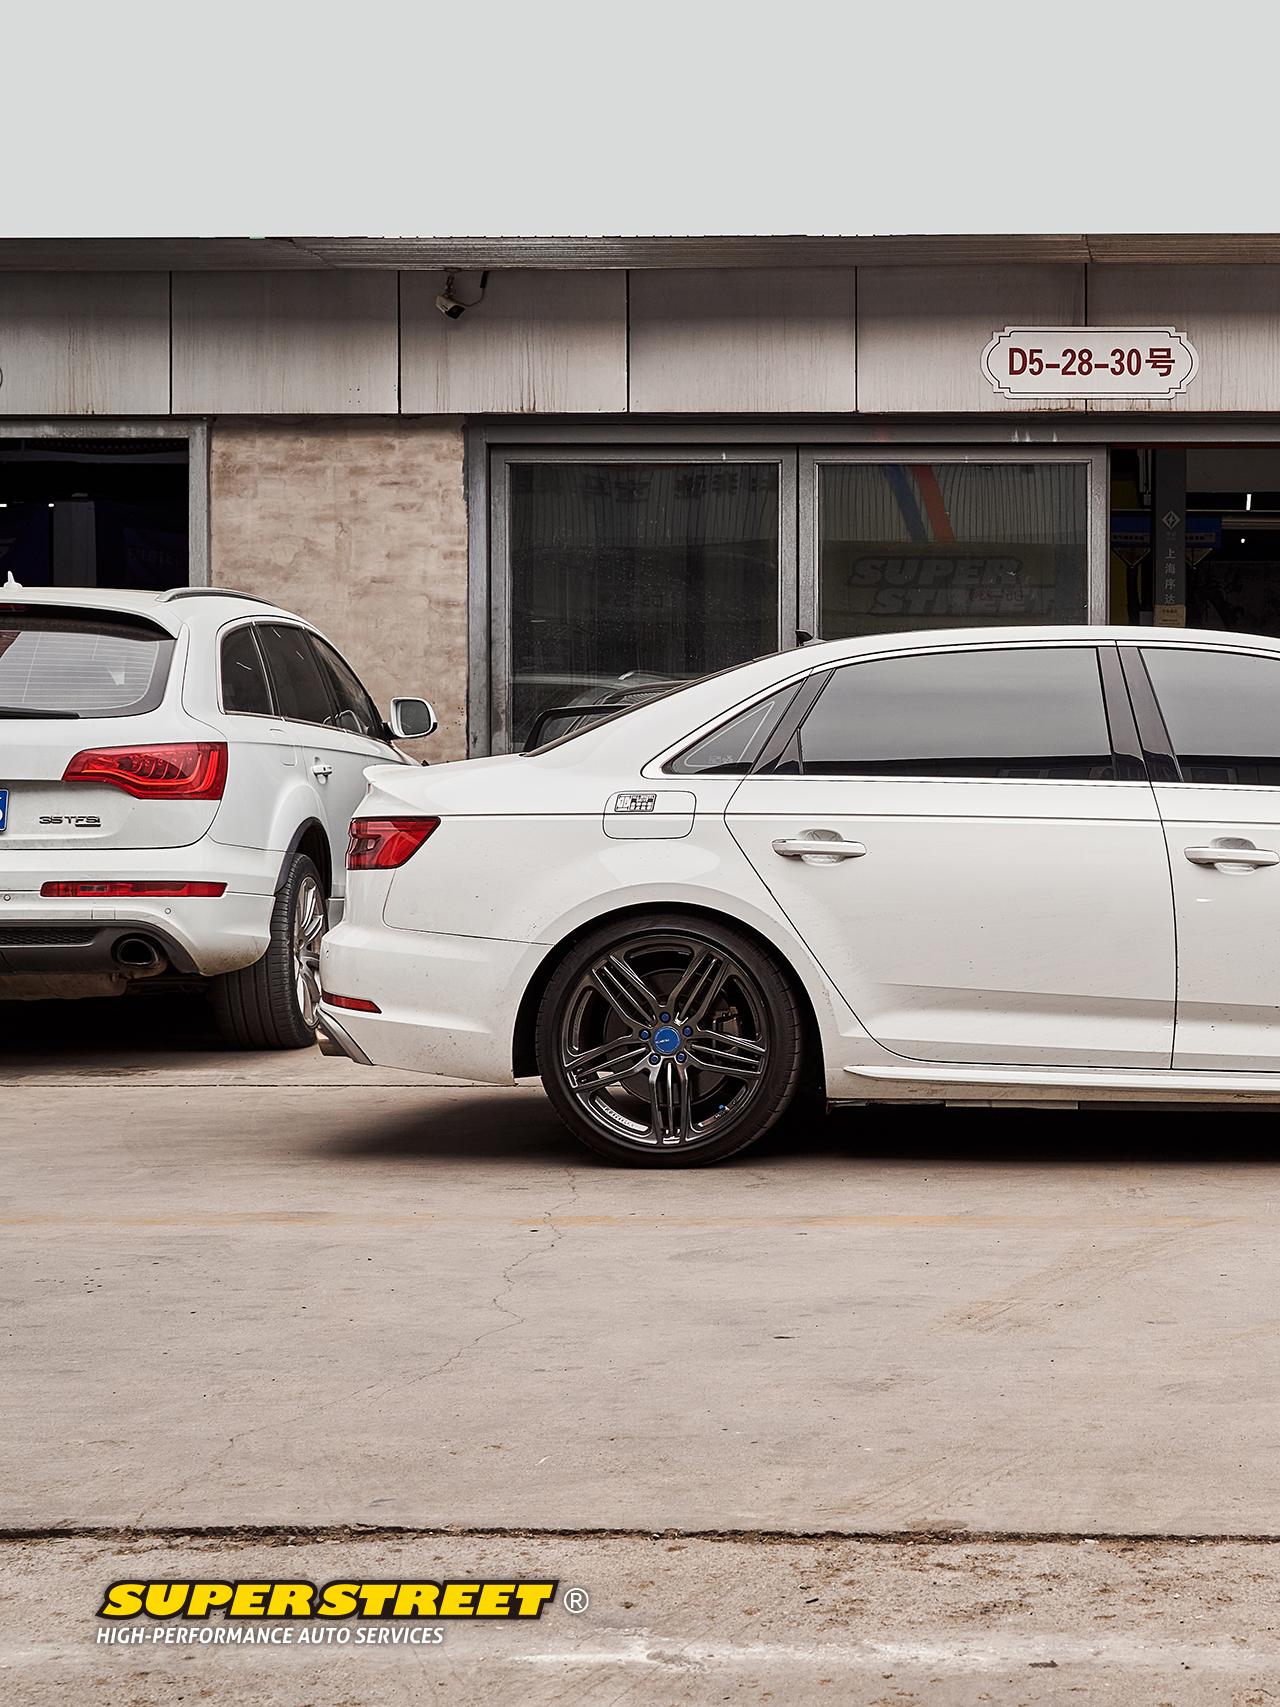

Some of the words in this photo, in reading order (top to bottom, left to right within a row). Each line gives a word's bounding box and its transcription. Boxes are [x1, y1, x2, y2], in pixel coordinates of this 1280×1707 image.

[1008, 347, 1176, 377] D5-28-30号
[847, 556, 1023, 587] SUPER
[39, 816, 63, 824] 35
[64, 816, 101, 825] TFSI
